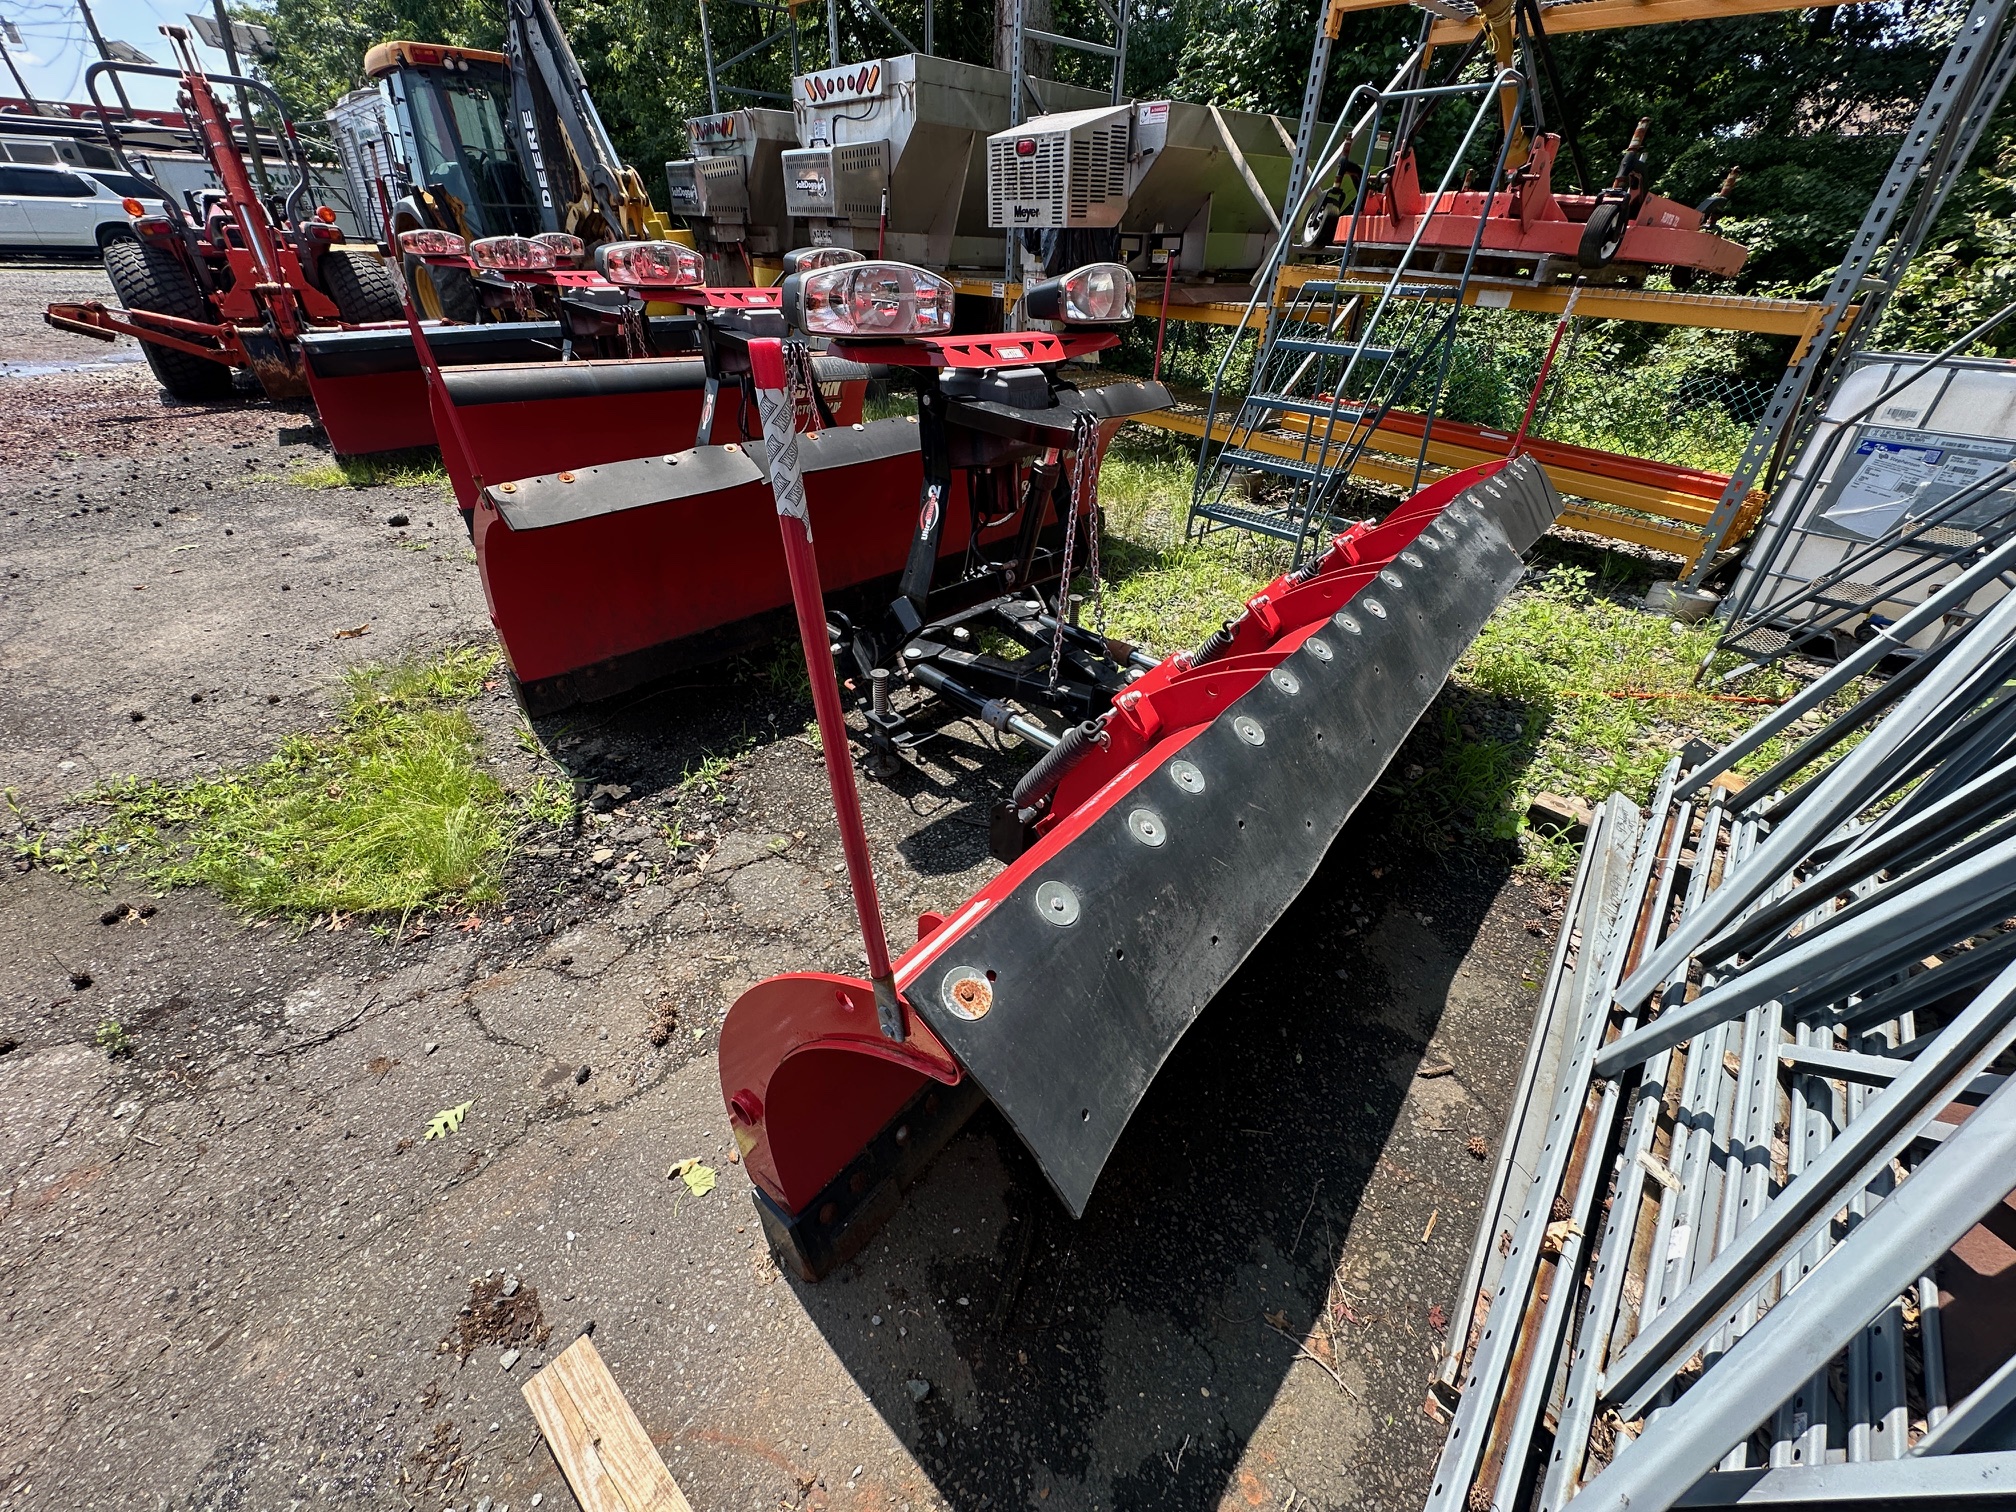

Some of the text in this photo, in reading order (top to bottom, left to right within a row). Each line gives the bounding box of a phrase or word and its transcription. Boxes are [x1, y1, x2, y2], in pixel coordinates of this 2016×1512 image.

[521, 110, 553, 208] DEERE
[1014, 205, 1040, 222] Meyer
[1889, 456, 1921, 468] Stephenson
[928, 485, 942, 499] 2
